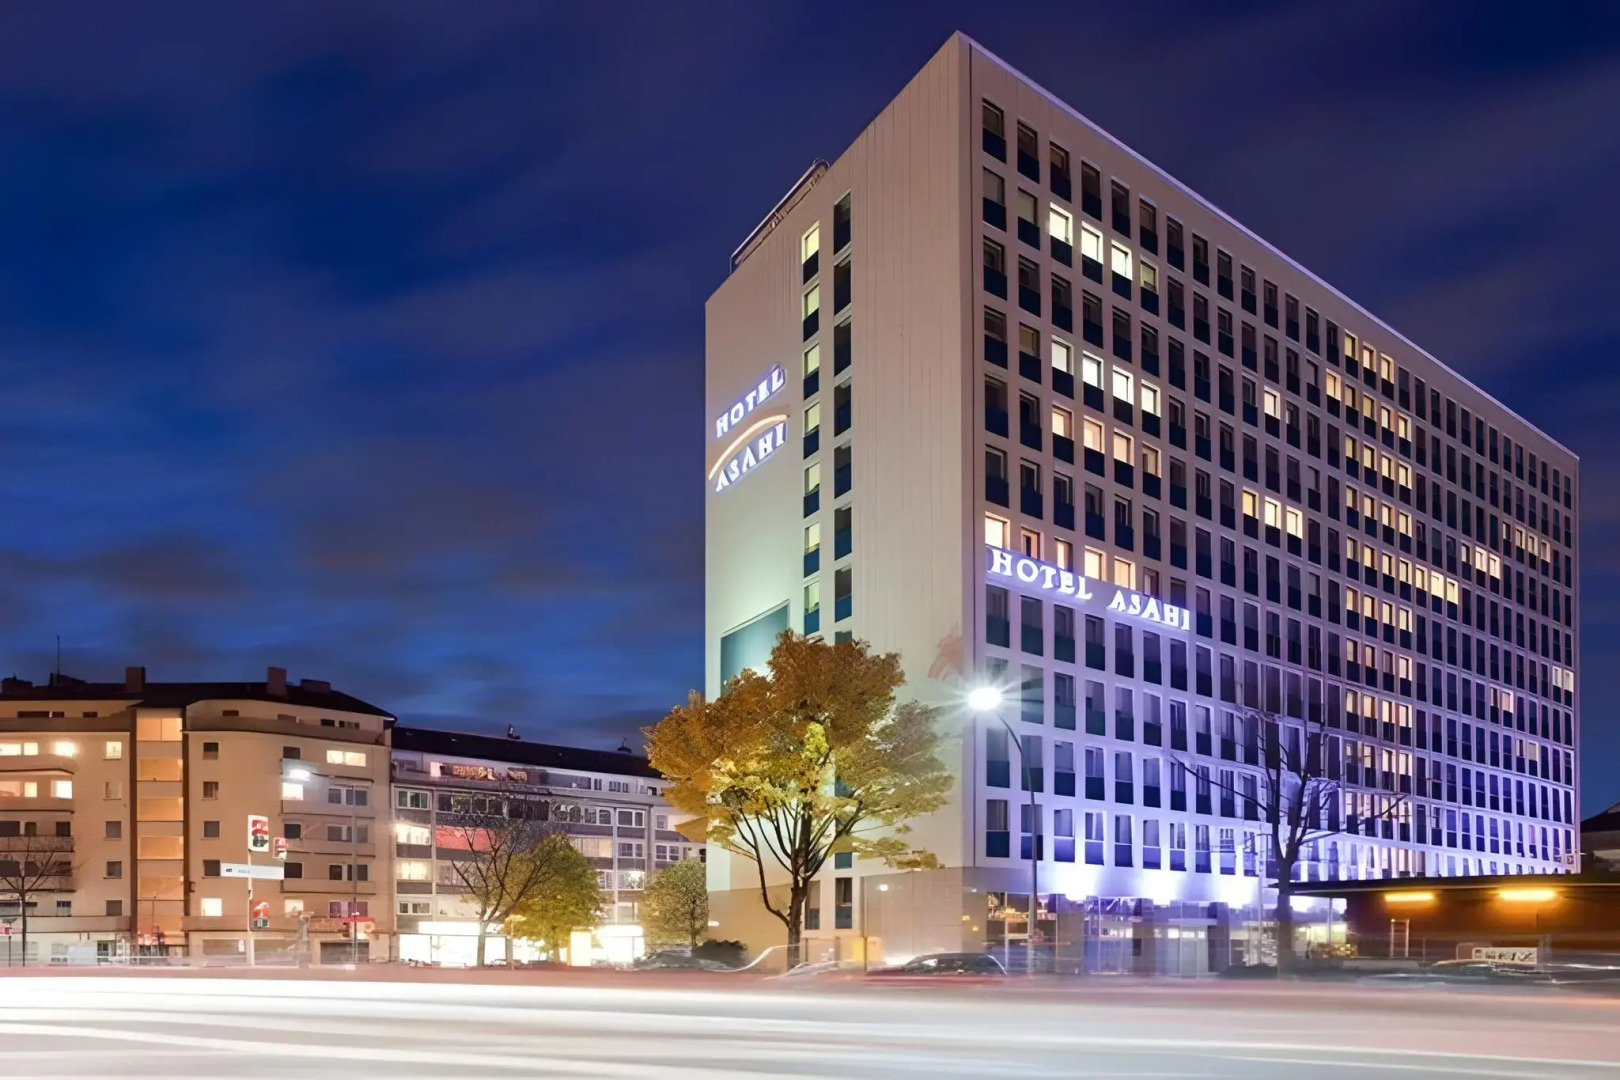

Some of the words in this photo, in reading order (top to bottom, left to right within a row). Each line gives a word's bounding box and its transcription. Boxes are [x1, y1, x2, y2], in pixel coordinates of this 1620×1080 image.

[715, 366, 785, 439] HOTEL
[715, 423, 786, 492] ASAHI
[989, 549, 1093, 601] HOTEL
[1106, 589, 1190, 631] ASAHI
